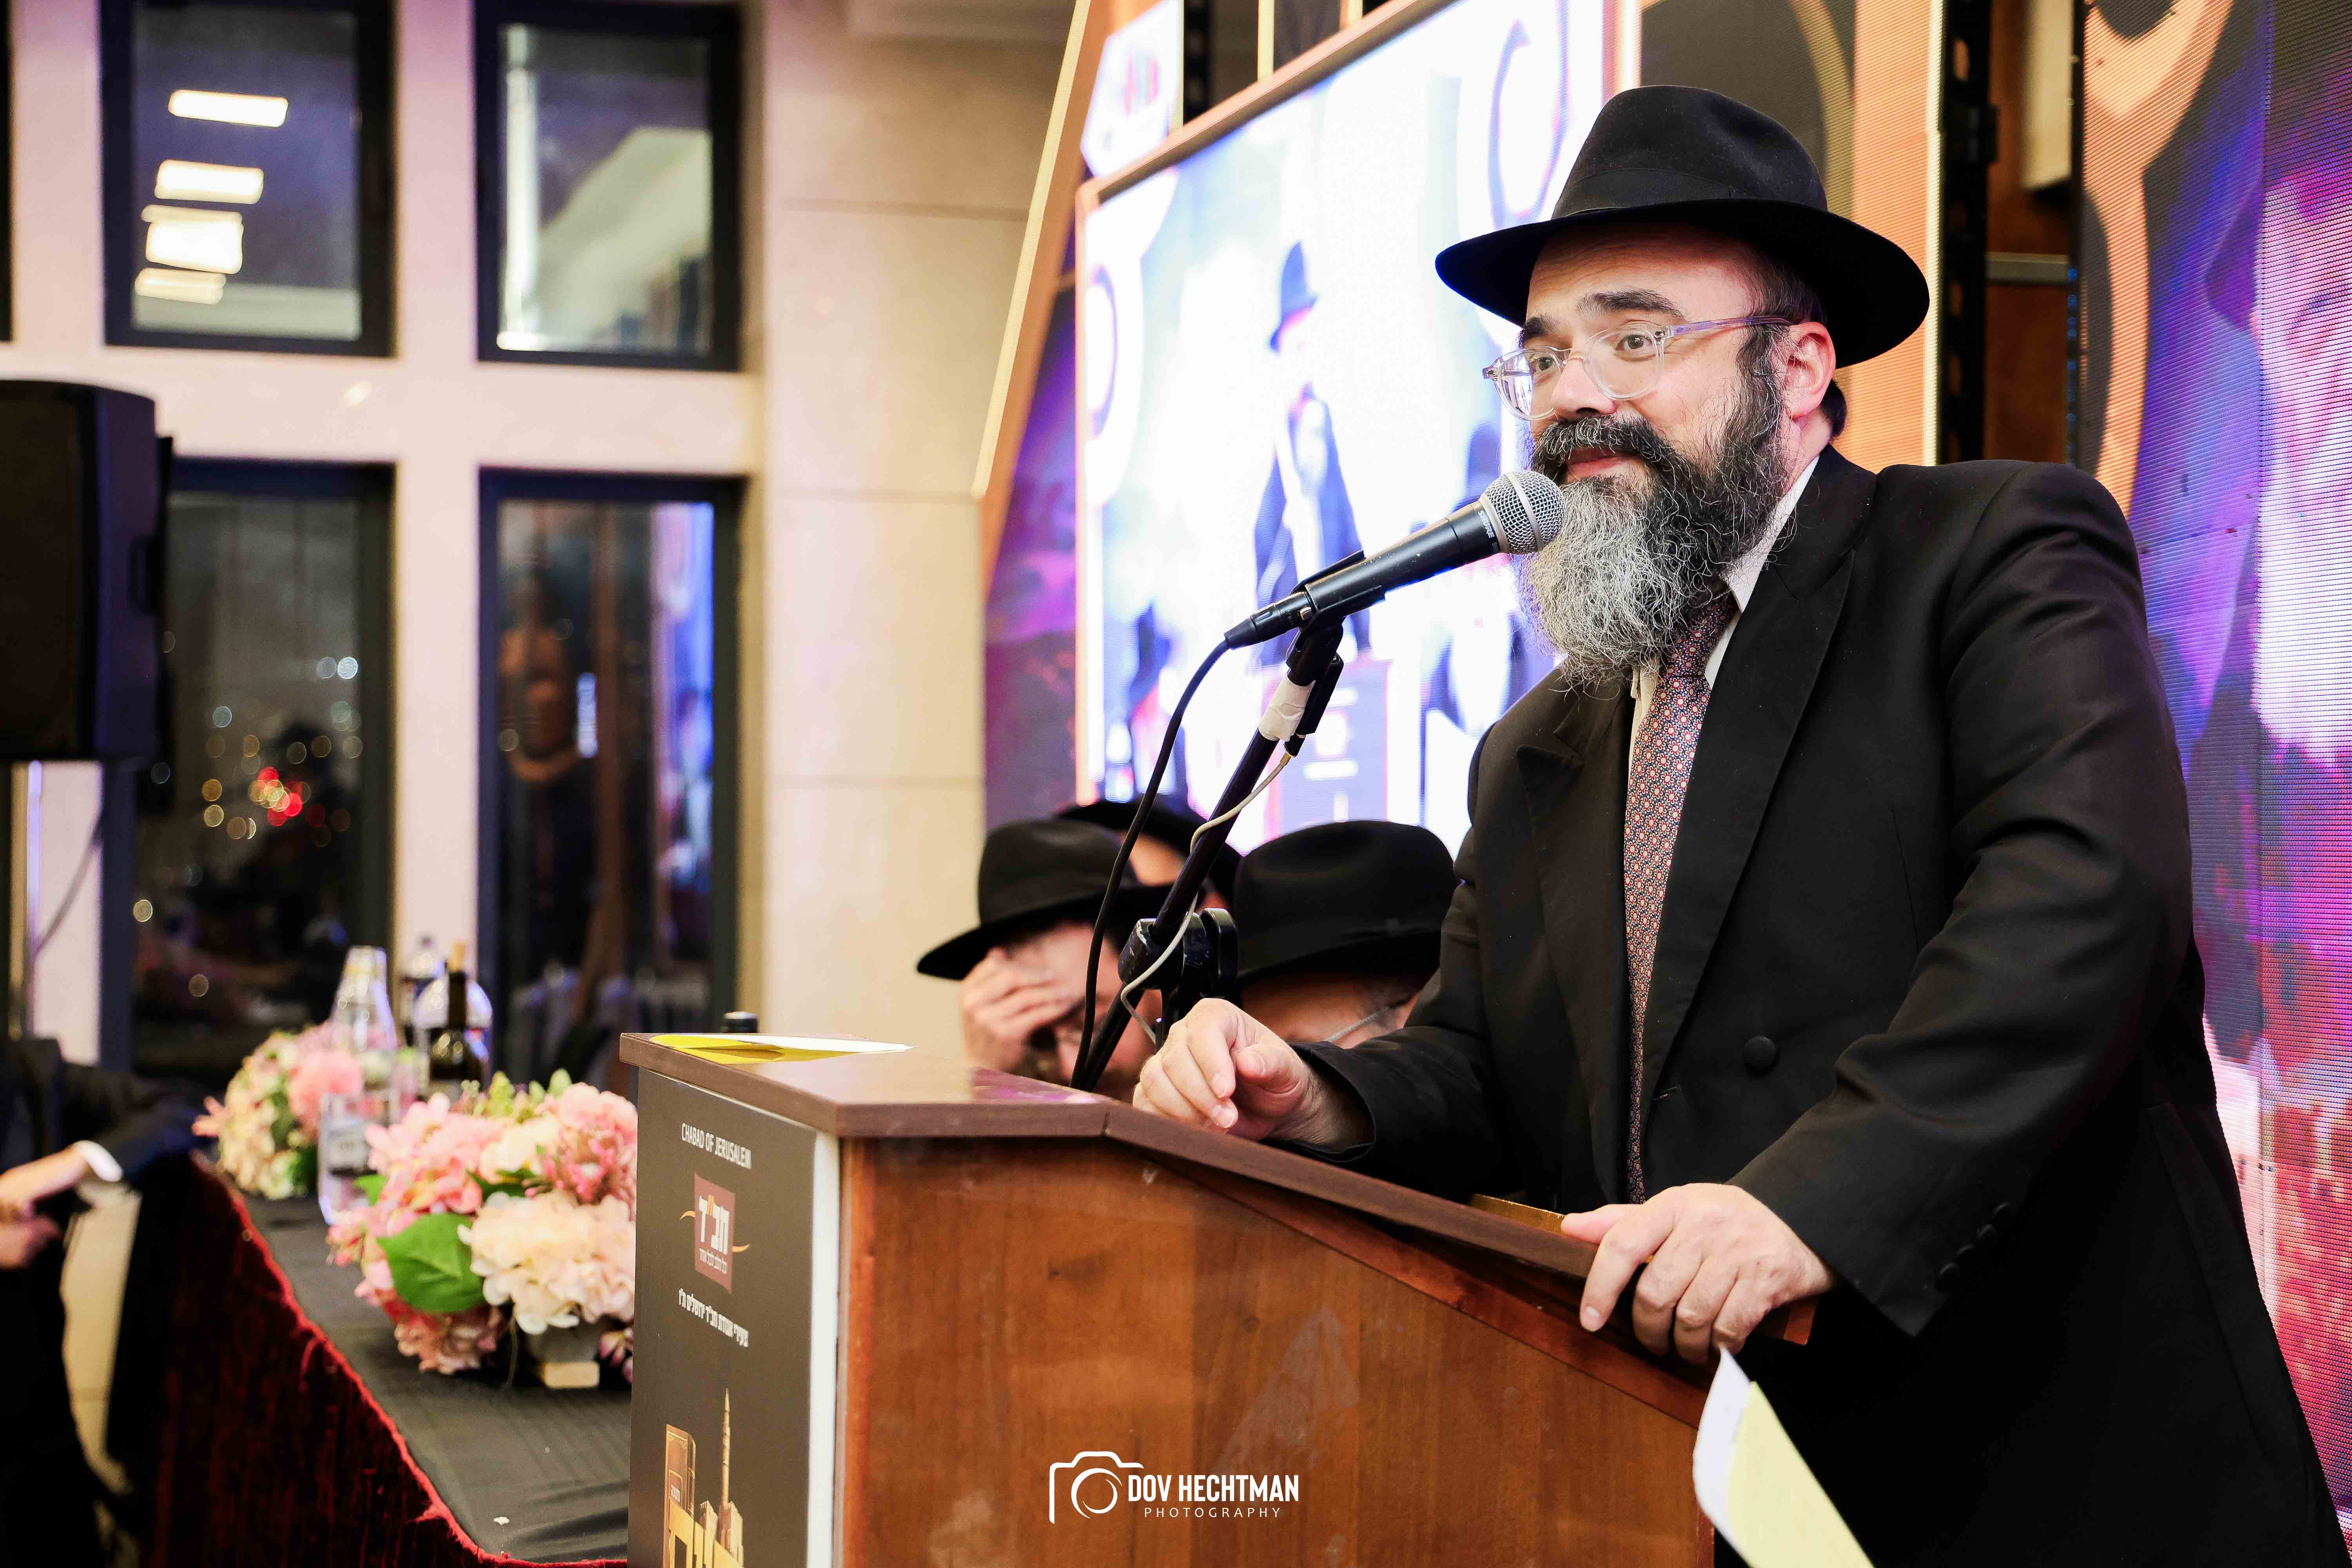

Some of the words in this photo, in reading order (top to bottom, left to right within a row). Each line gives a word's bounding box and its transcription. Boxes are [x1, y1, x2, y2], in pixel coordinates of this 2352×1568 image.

[1477, 510, 1495, 538] SHURE
[682, 1122, 704, 1149] CHABAD
[705, 1132, 715, 1152] OF
[715, 1136, 752, 1170] JERUSALEM
